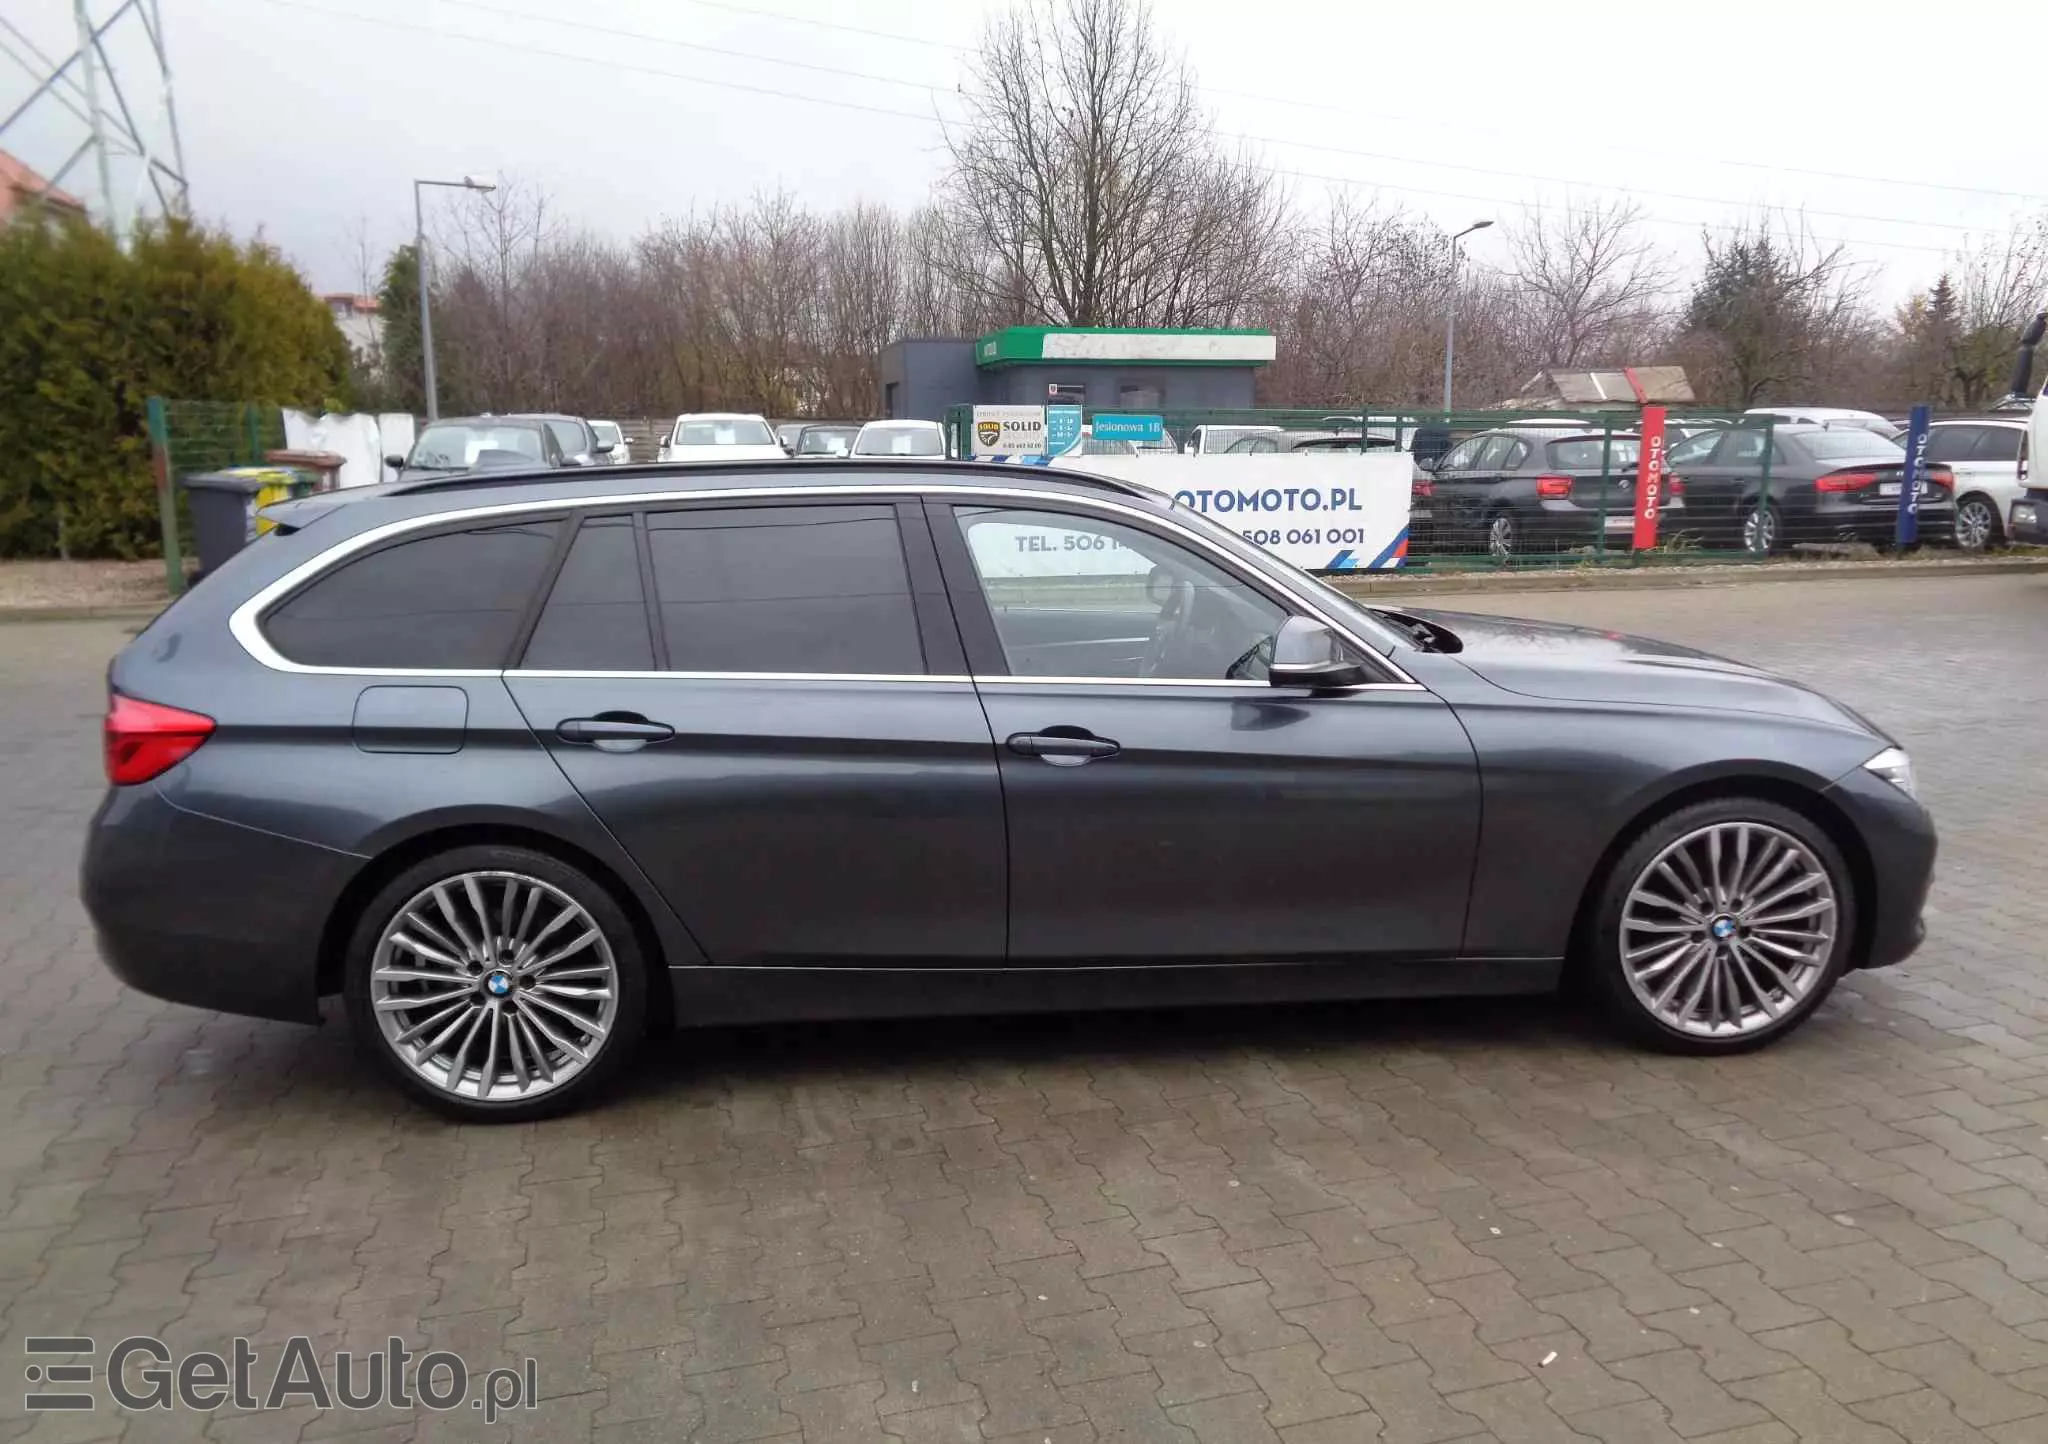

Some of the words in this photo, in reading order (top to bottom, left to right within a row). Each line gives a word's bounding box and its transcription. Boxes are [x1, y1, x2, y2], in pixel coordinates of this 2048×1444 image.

[1002, 421, 1041, 432] SOLID
[1644, 435, 1662, 520] OTOMOTO
[1907, 433, 1928, 515] OTOMOTO
[1015, 535, 1057, 552] TEL.
[1064, 535, 1105, 551] 506
[1286, 529, 1320, 545] 061
[1326, 528, 1364, 544] 001
